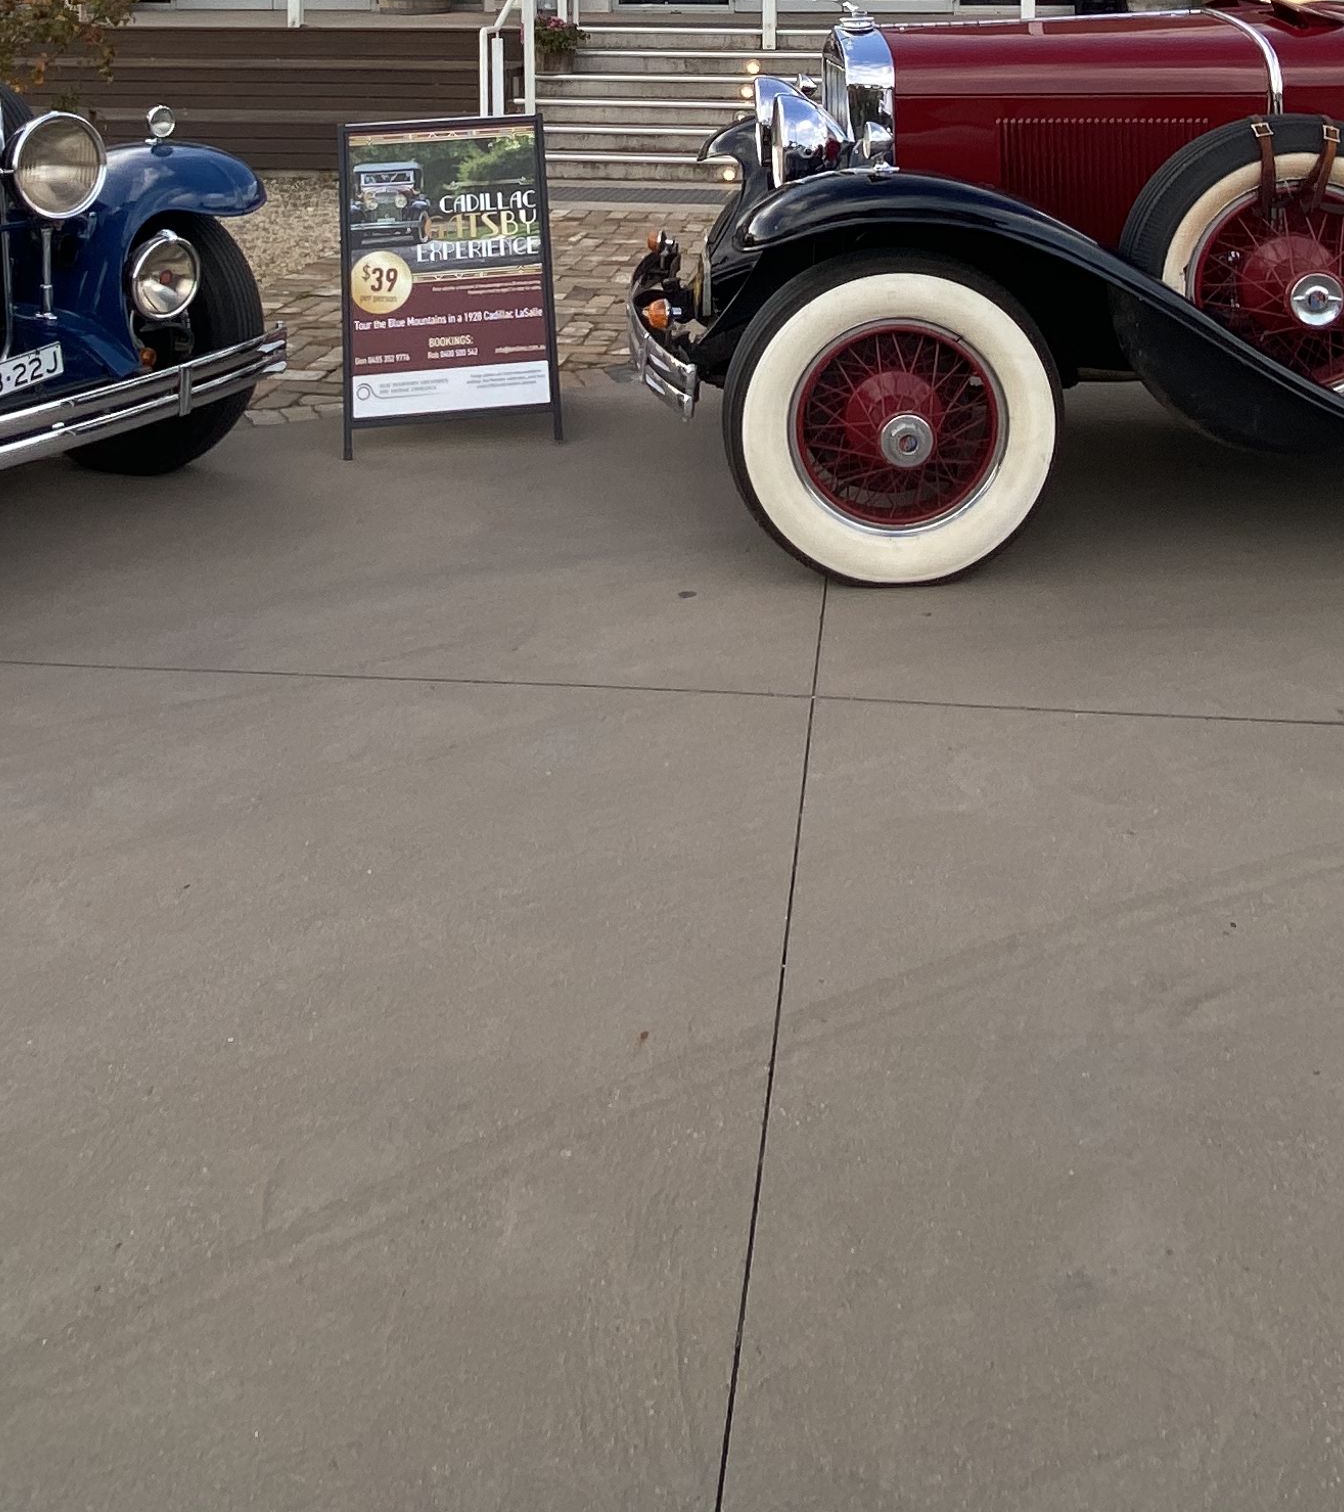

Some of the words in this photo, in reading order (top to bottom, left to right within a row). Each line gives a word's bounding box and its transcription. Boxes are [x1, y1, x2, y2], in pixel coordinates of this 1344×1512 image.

[439, 189, 536, 214] CADILLAC
[424, 208, 537, 240] GATSBY
[416, 235, 540, 263] EXPERIENCE
[353, 320, 372, 331] Tour
[373, 320, 387, 329] the
[387, 318, 406, 328] Blue
[406, 314, 447, 326] Mountains
[448, 313, 456, 323] in
[456, 314, 463, 323] a
[483, 309, 515, 321] Cadillac
[515, 307, 544, 319] LaSalle
[428, 334, 474, 348] BOOKINGS:
